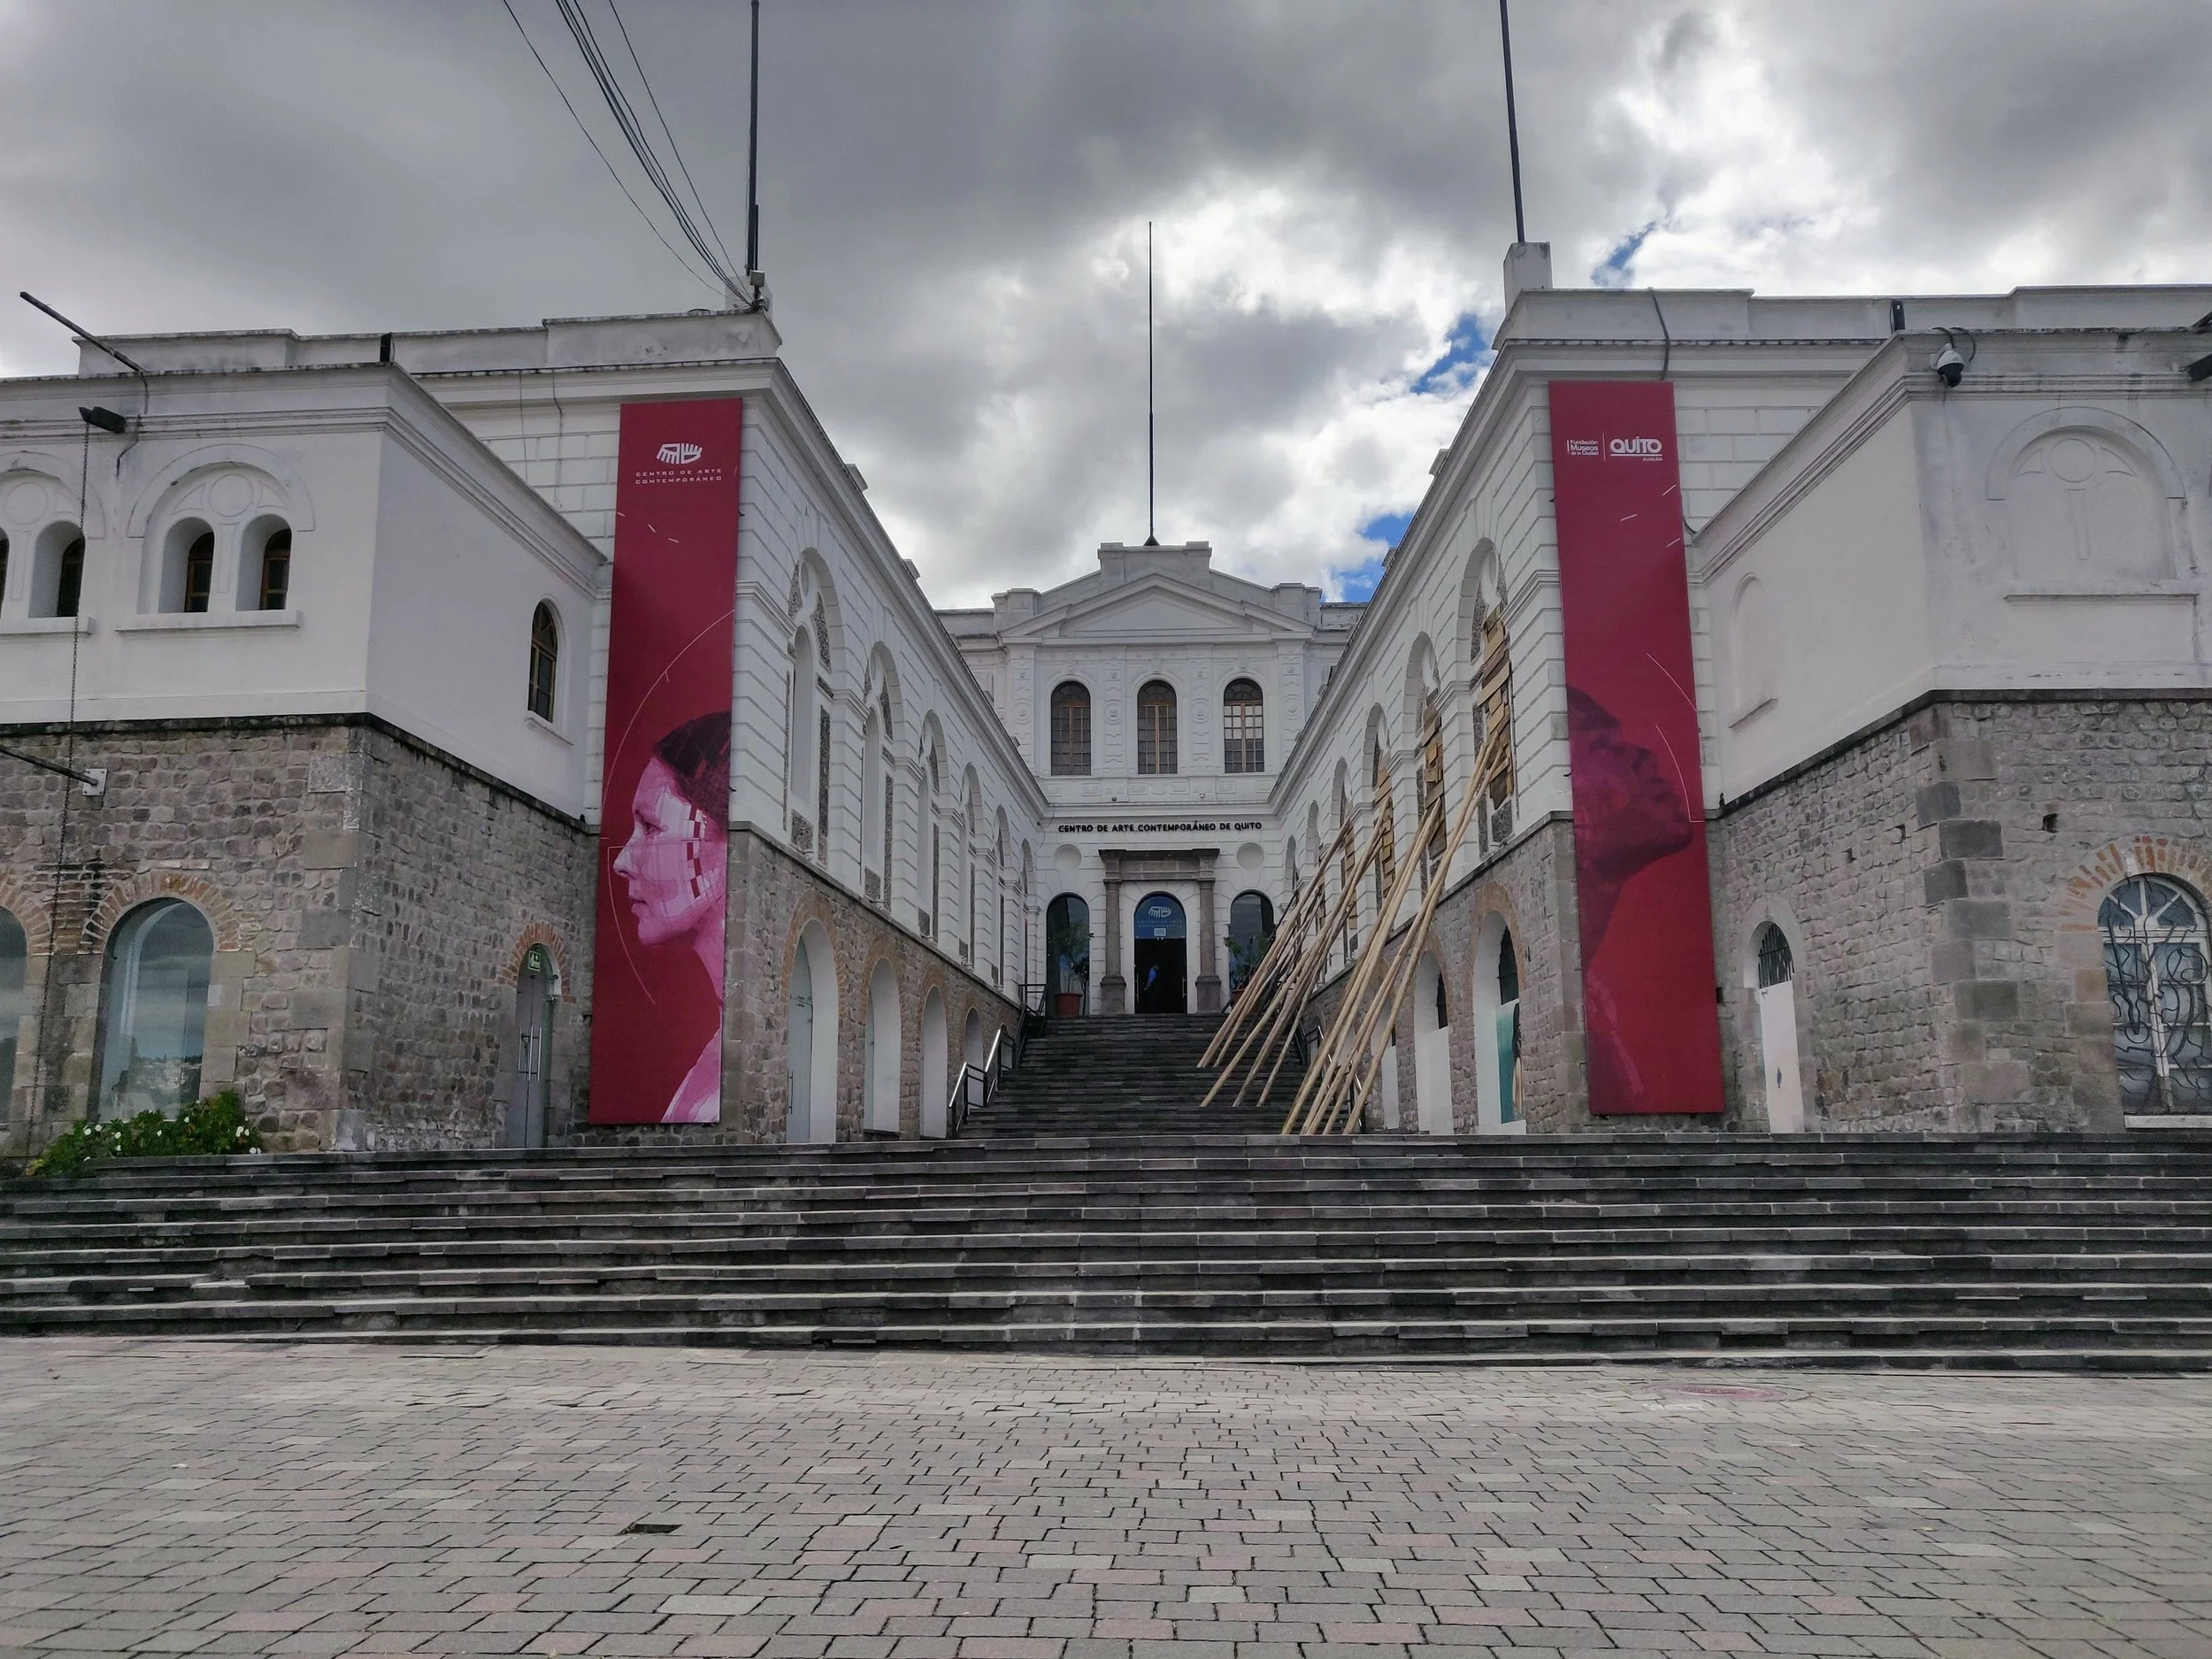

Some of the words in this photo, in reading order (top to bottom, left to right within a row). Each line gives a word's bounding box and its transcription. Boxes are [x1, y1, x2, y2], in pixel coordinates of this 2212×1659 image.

[1057, 824, 1094, 833] CENTRO
[1096, 824, 1109, 833] DE
[1111, 824, 1134, 833] ARTE
[1137, 820, 1217, 833] CONTEMPORÁNEO
[1219, 822, 1232, 831] DE
[1233, 821, 1263, 832] QUITO
